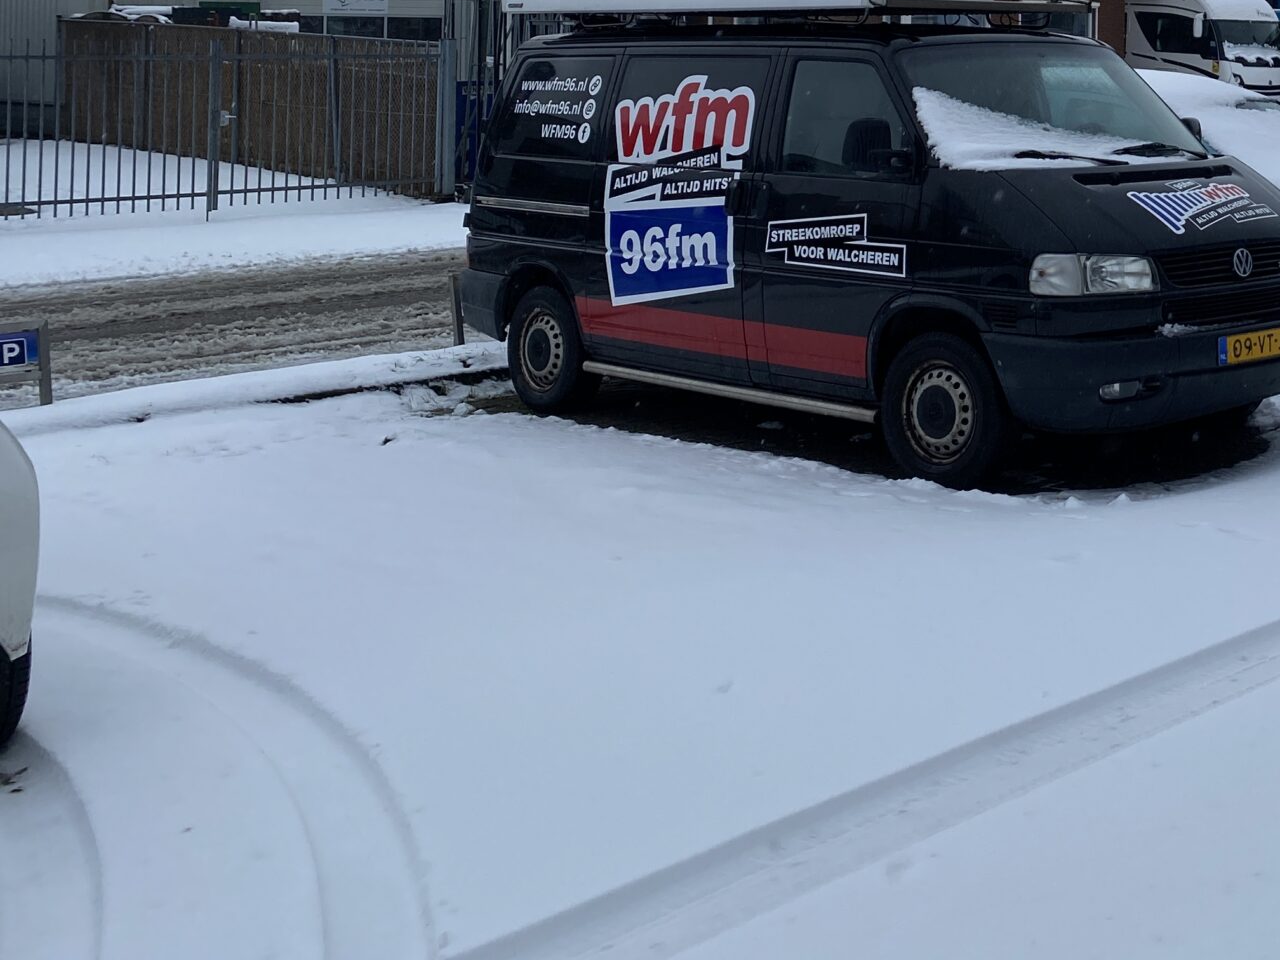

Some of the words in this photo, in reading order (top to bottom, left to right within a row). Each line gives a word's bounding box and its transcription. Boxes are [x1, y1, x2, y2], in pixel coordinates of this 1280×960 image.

[521, 76, 588, 92] www.wfm96.nl
[513, 99, 582, 116] info@wfm96.nl
[617, 79, 752, 158] wfm
[541, 123, 577, 139] WFM96
[613, 170, 649, 190] ALTIJD
[651, 152, 719, 179] WALCHEREN
[663, 180, 700, 195] ALTIJD
[1202, 184, 1247, 201] wfm
[1196, 210, 1219, 224] ALTIJD
[770, 224, 861, 243] STREEKOMROEP
[619, 223, 719, 275] 96fm
[793, 244, 825, 260] VOOR
[827, 247, 899, 267] WALCHEREN
[2, 343, 20, 364] P
